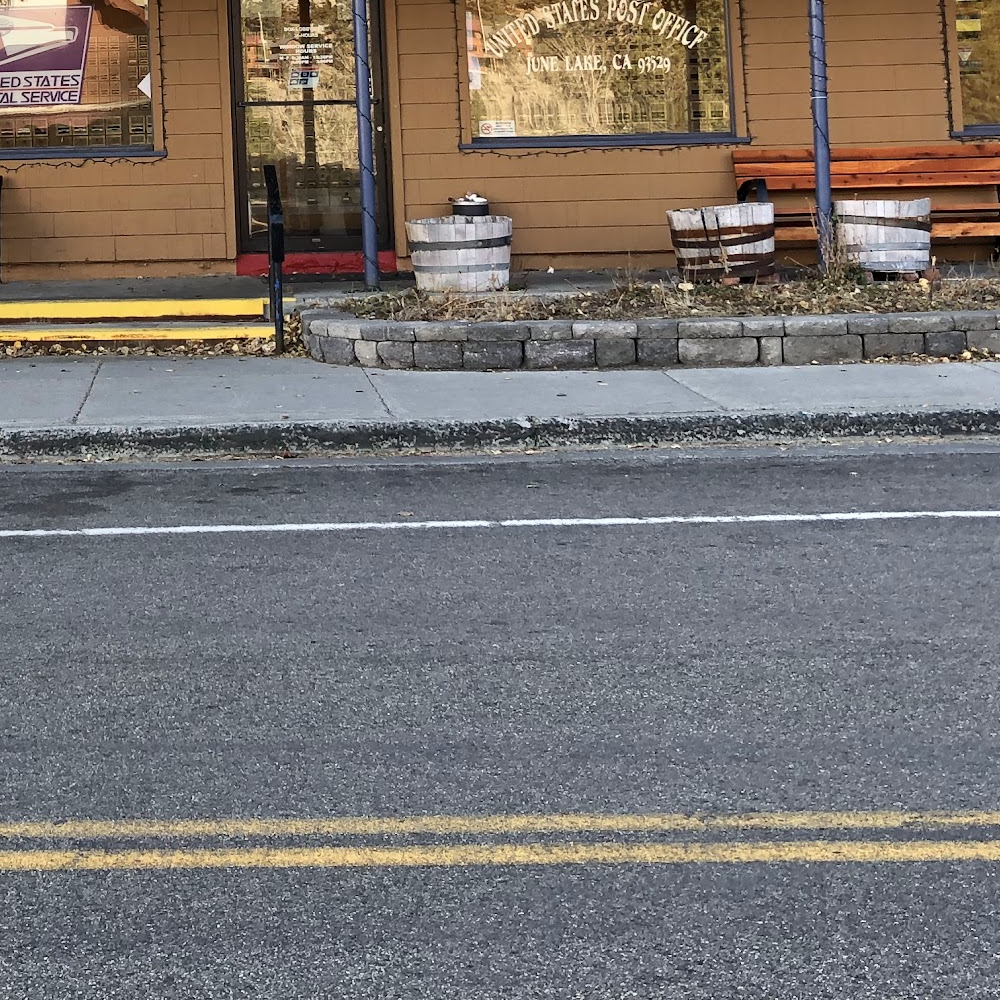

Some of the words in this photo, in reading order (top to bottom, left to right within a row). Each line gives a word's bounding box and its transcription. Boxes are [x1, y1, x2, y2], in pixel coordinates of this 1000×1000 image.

[485, 13, 541, 59] UNITED
[652, 8, 709, 50] OFFICE
[526, 56, 560, 76] JUNE
[565, 54, 608, 74] LAKE,
[612, 54, 633, 70] CA
[637, 57, 672, 74] 93529
[23, 75, 80, 88] STATES
[21, 90, 78, 103] SERVICE
